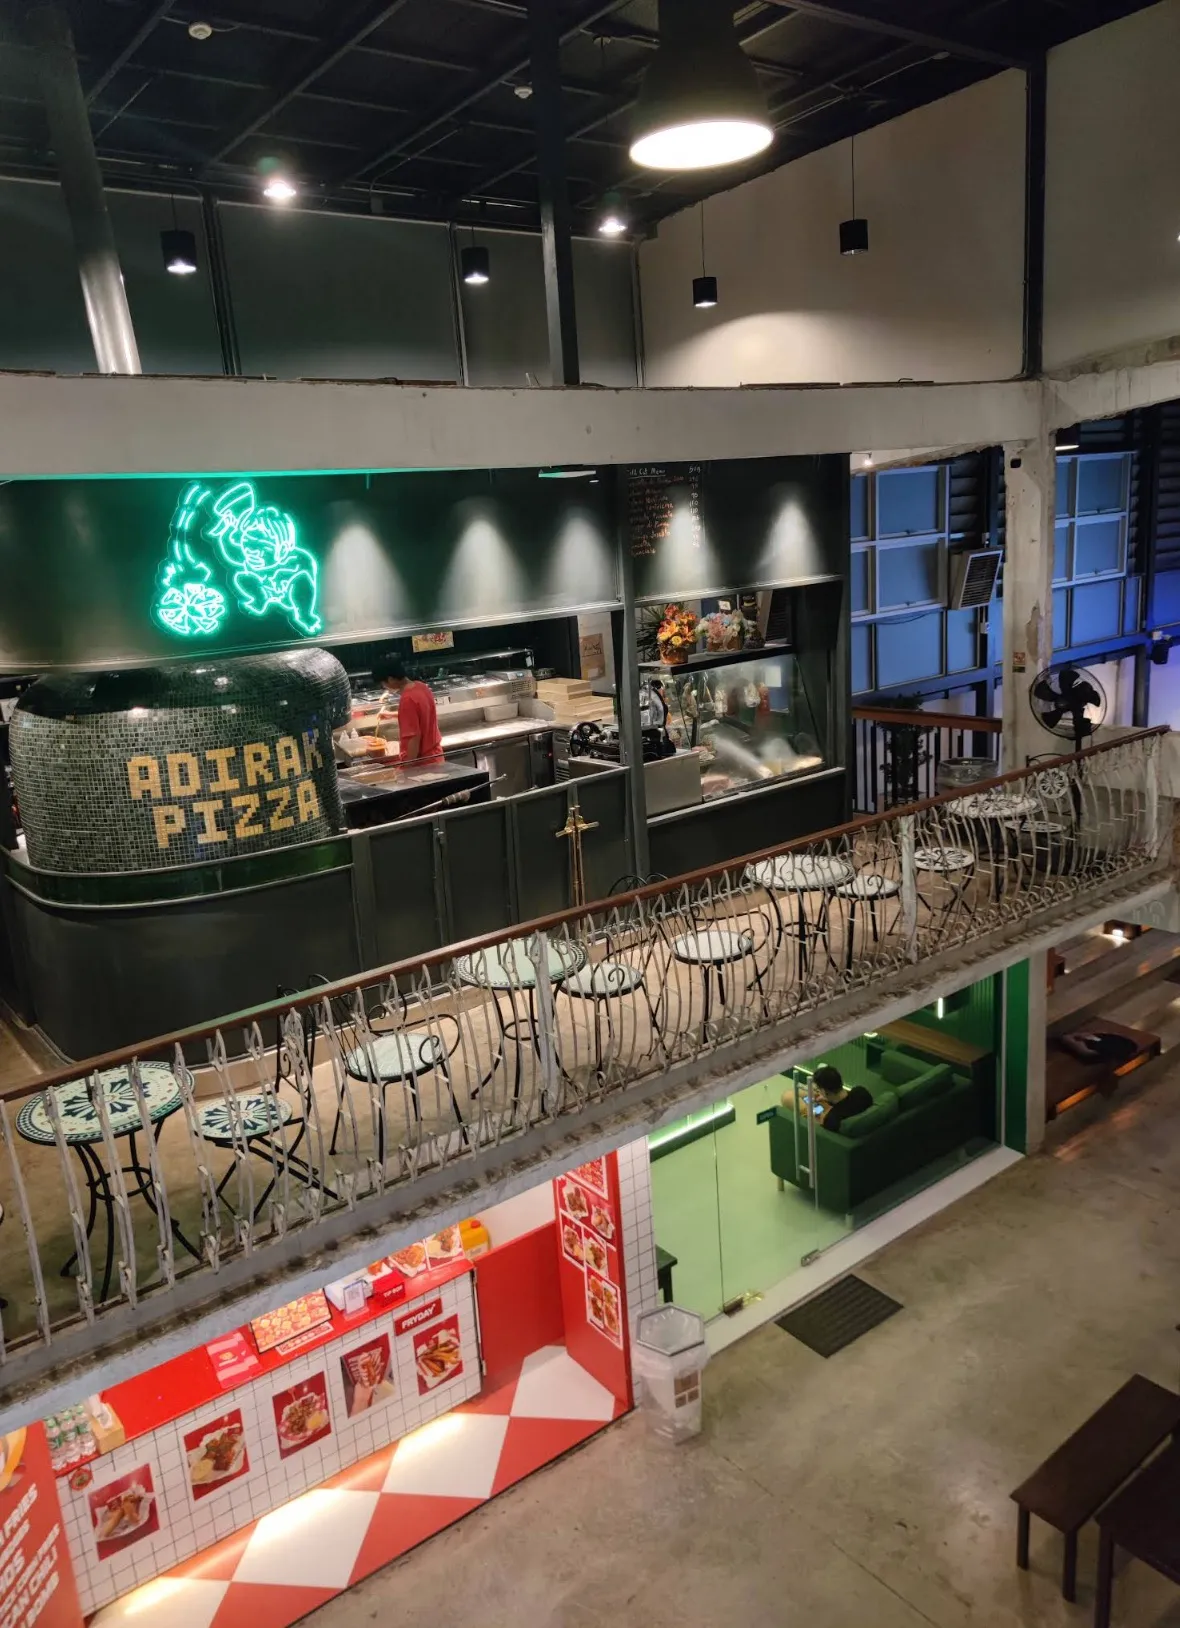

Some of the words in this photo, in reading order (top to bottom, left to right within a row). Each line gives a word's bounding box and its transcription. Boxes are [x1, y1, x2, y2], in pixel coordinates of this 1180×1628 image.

[127, 728, 324, 801] ADIRAK
[151, 779, 320, 849] PIZZA
[402, 1303, 436, 1329] FRYDAY
